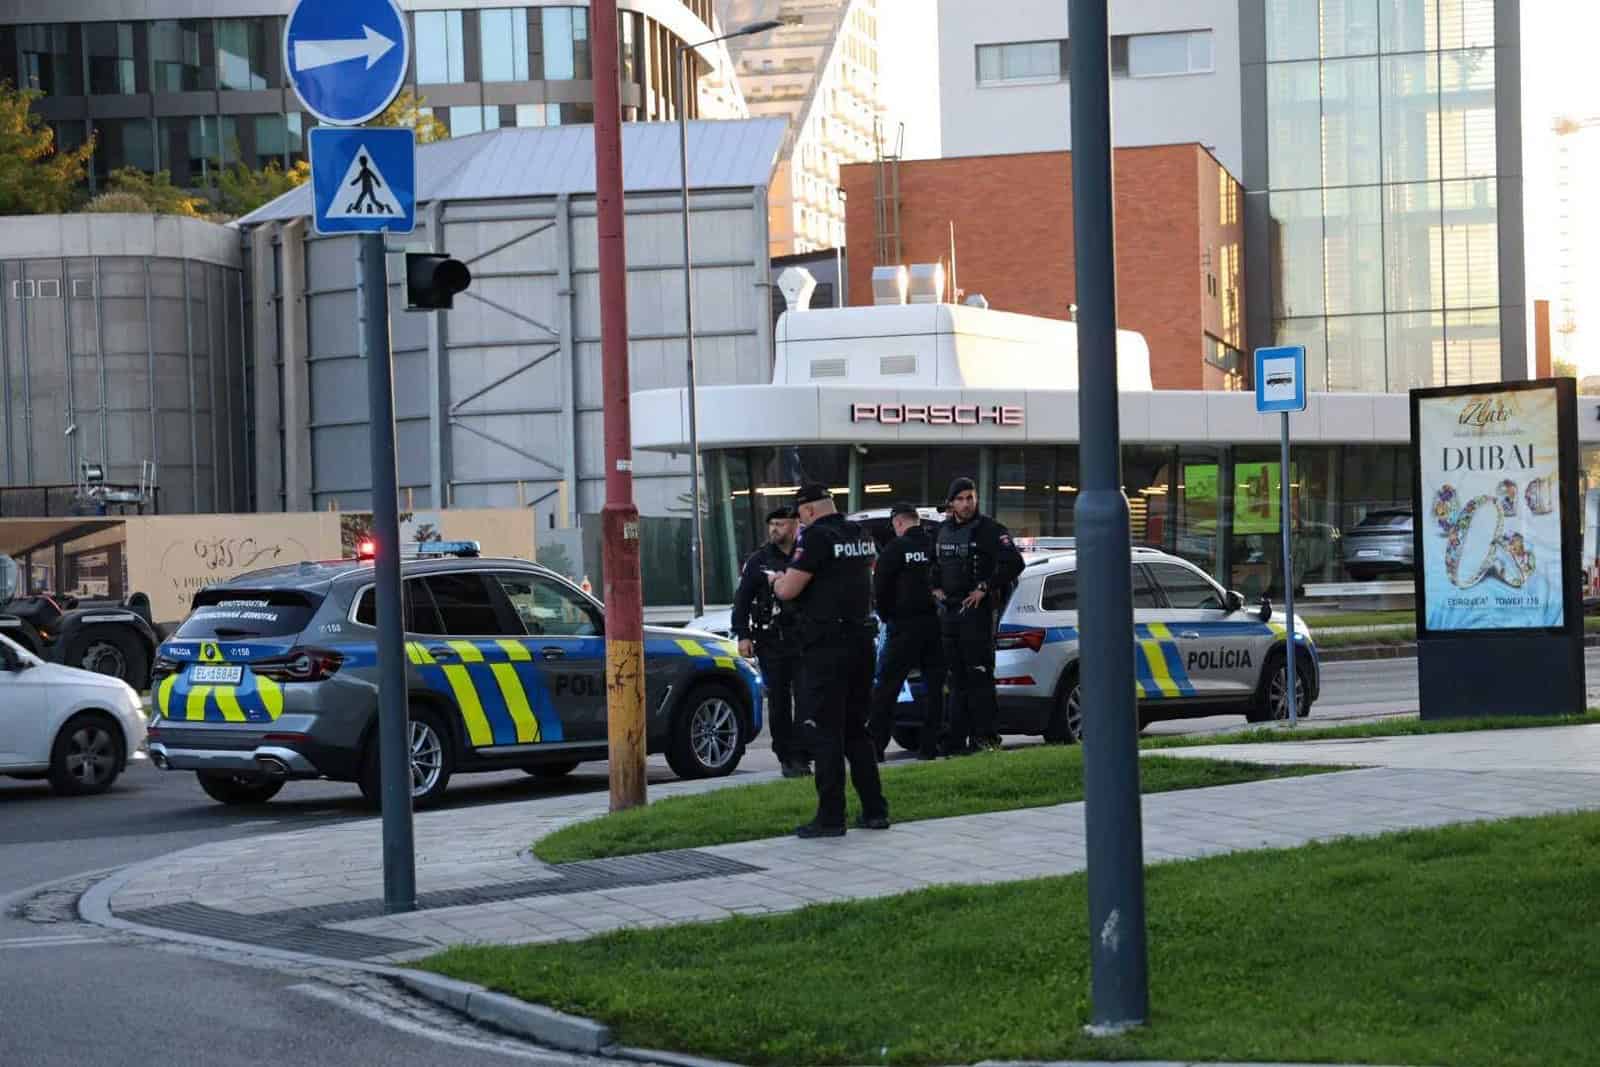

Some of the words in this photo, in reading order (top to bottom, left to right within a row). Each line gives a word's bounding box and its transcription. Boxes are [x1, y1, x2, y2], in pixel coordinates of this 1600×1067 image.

[851, 404, 1024, 425] PORSCHE
[1443, 444, 1535, 472] DUBAI
[833, 539, 877, 558] POLÍCIA
[1187, 645, 1252, 671] POLÍCIA
